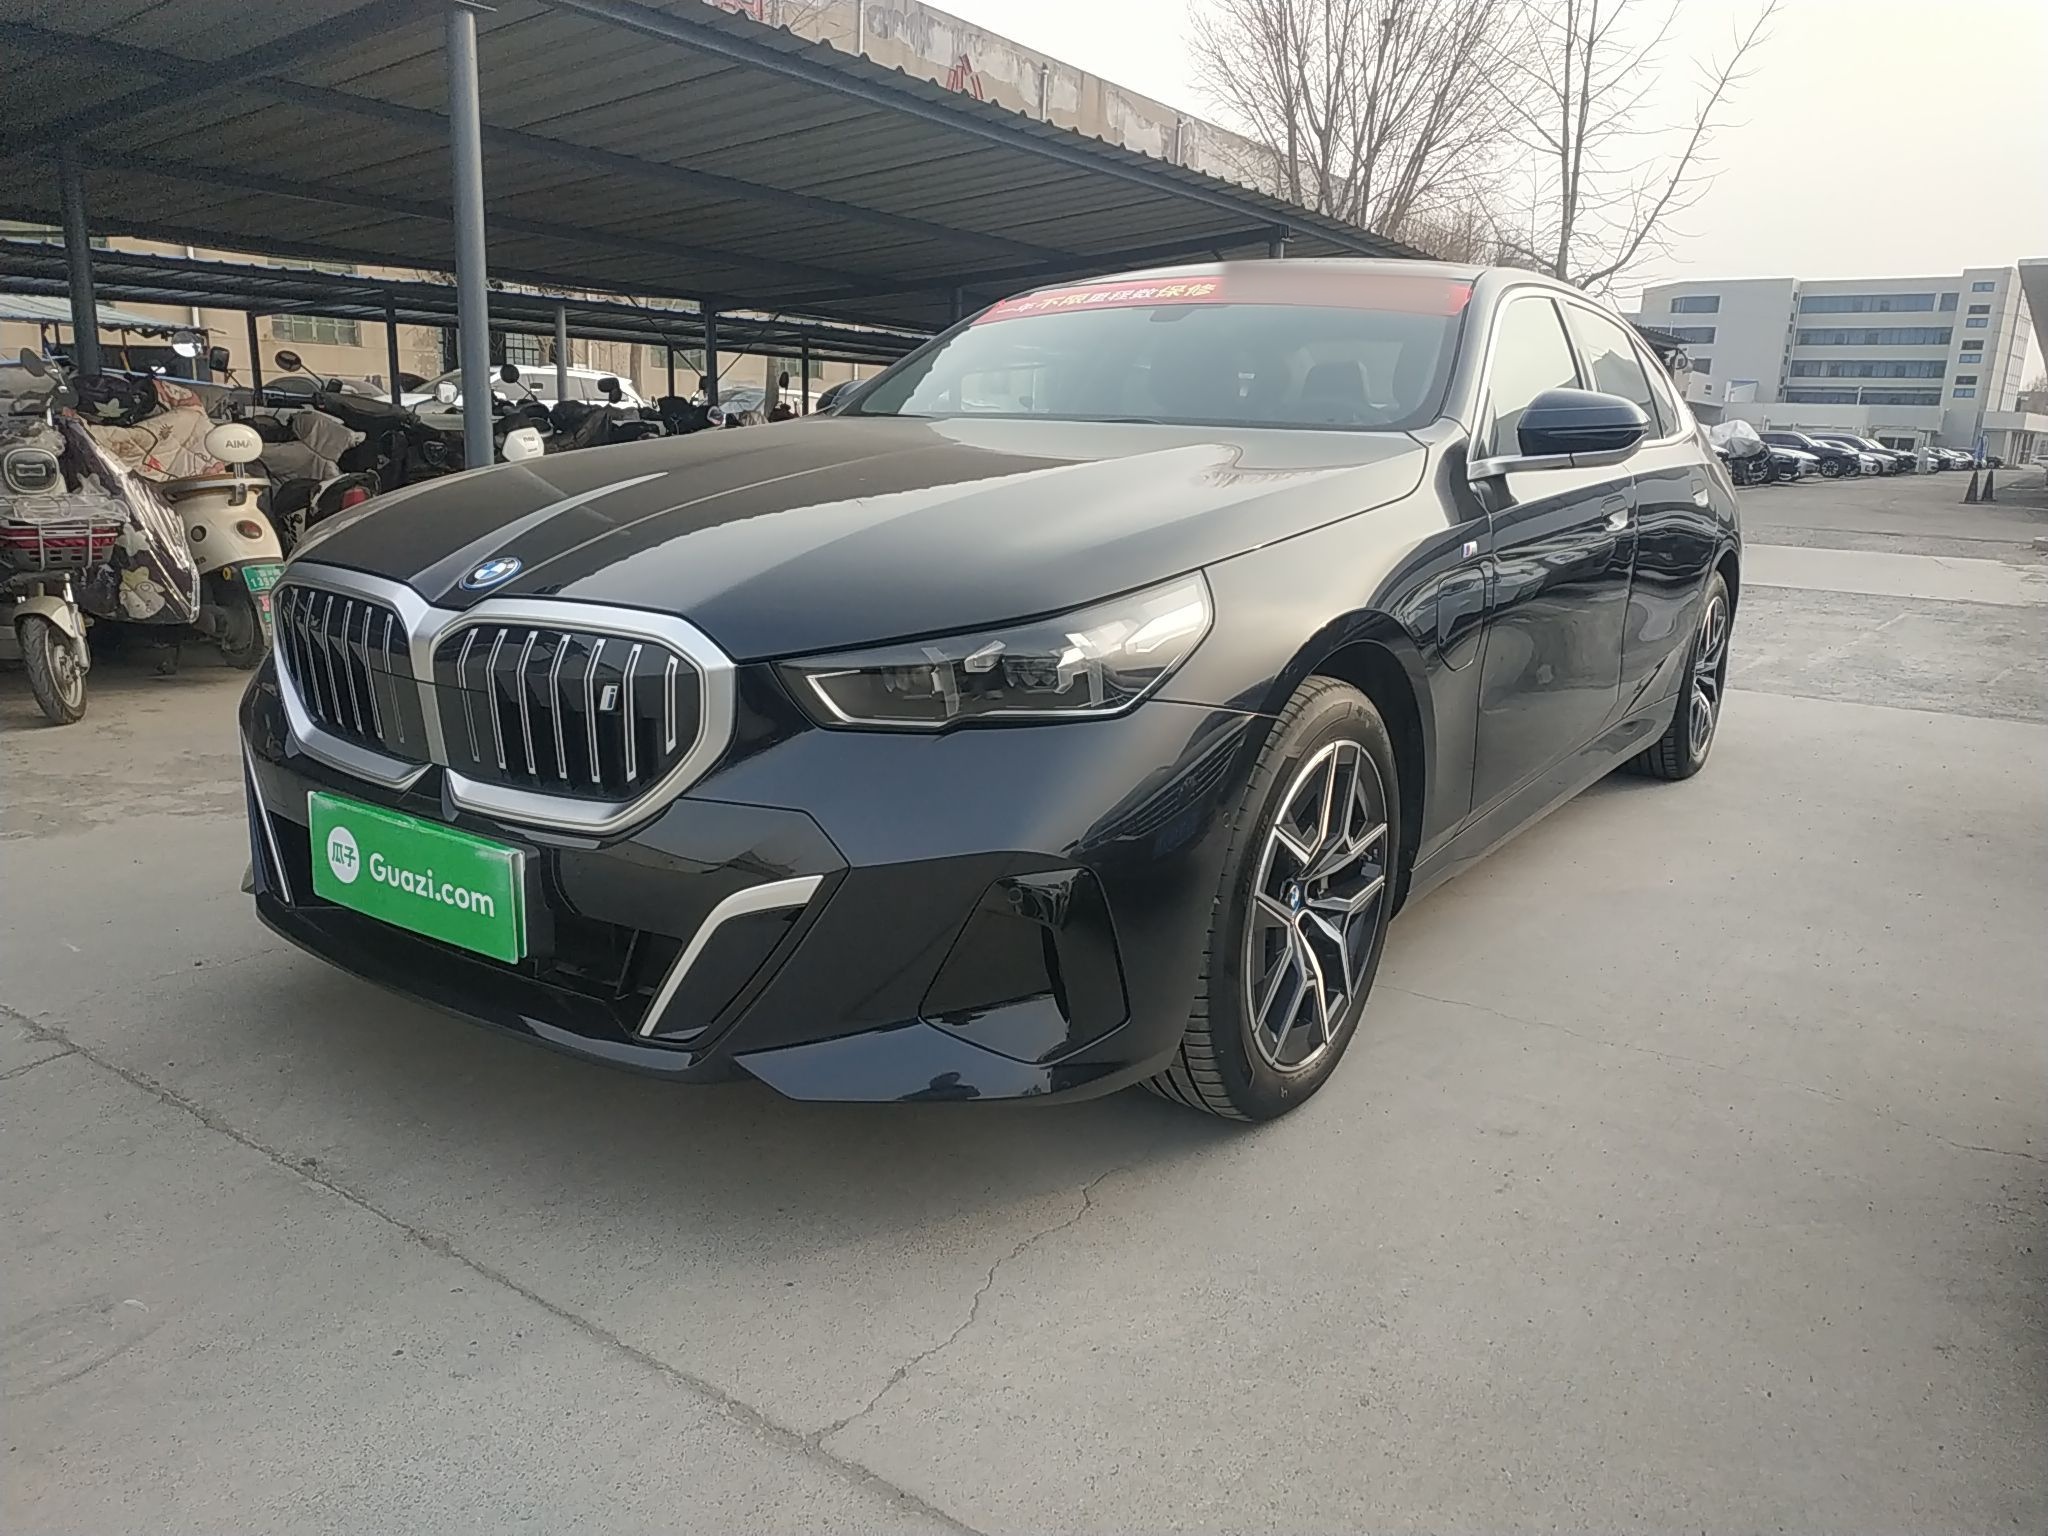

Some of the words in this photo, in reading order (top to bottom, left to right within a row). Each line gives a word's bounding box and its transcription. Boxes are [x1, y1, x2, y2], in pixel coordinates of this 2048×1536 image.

[225, 439, 253, 449] AIMA
[331, 841, 356, 868] 瓜子
[369, 852, 495, 918] Guazi.com
